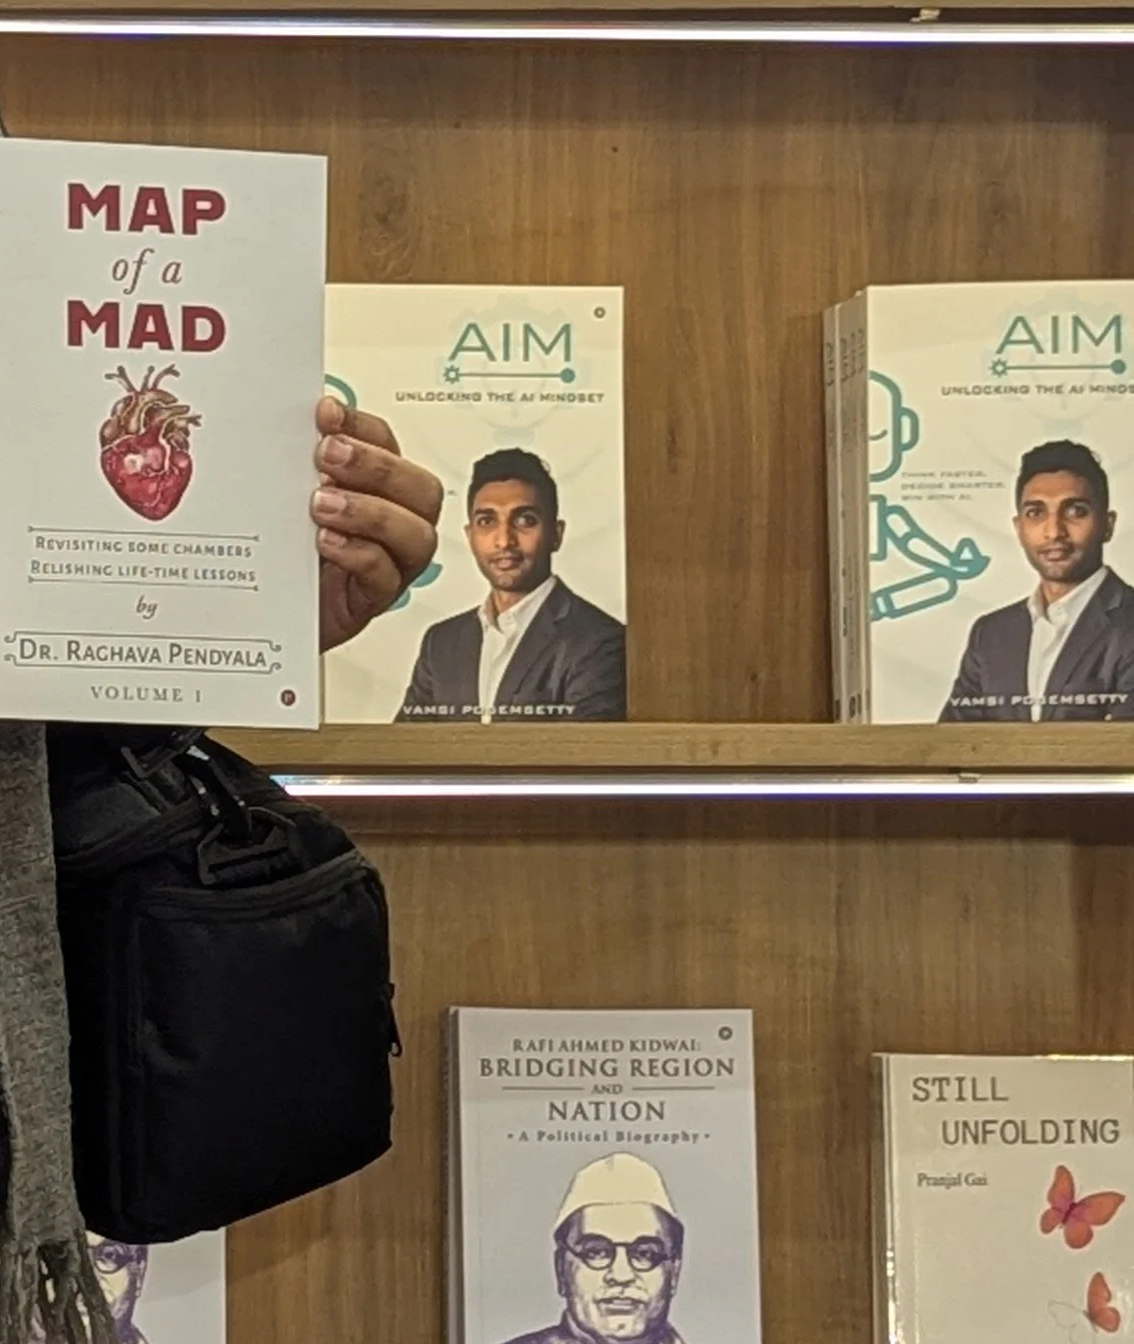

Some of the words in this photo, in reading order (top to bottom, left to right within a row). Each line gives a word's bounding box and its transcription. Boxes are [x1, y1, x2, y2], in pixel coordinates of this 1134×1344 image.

[67, 183, 226, 236] MAP
[111, 248, 155, 294] of
[161, 262, 183, 284] a
[67, 300, 226, 352] MAD
[995, 315, 1122, 354] AIM
[448, 322, 571, 362] AIM
[395, 391, 482, 402] UNLOCKING
[487, 392, 515, 402] THE
[520, 392, 535, 402] AI
[540, 392, 604, 403] MINDSET
[941, 385, 1030, 396] UNLOCKING
[1035, 384, 1065, 395] THE
[1069, 385, 1085, 395] AI
[136, 595, 158, 620] by
[91, 686, 183, 702] VOLUME
[513, 1038, 554, 1052] RAFI
[558, 1038, 624, 1052] AHMED
[480, 1058, 619, 1077] BRIDGING
[630, 1058, 735, 1077] REGION
[591, 1084, 623, 1095] AND
[912, 1076, 1009, 1102] STILL
[548, 1101, 666, 1122] NATION
[518, 1132, 530, 1142] A
[537, 1131, 609, 1142] Political
[616, 1131, 700, 1144] Biography
[942, 1118, 1120, 1145] UNFOLDING
